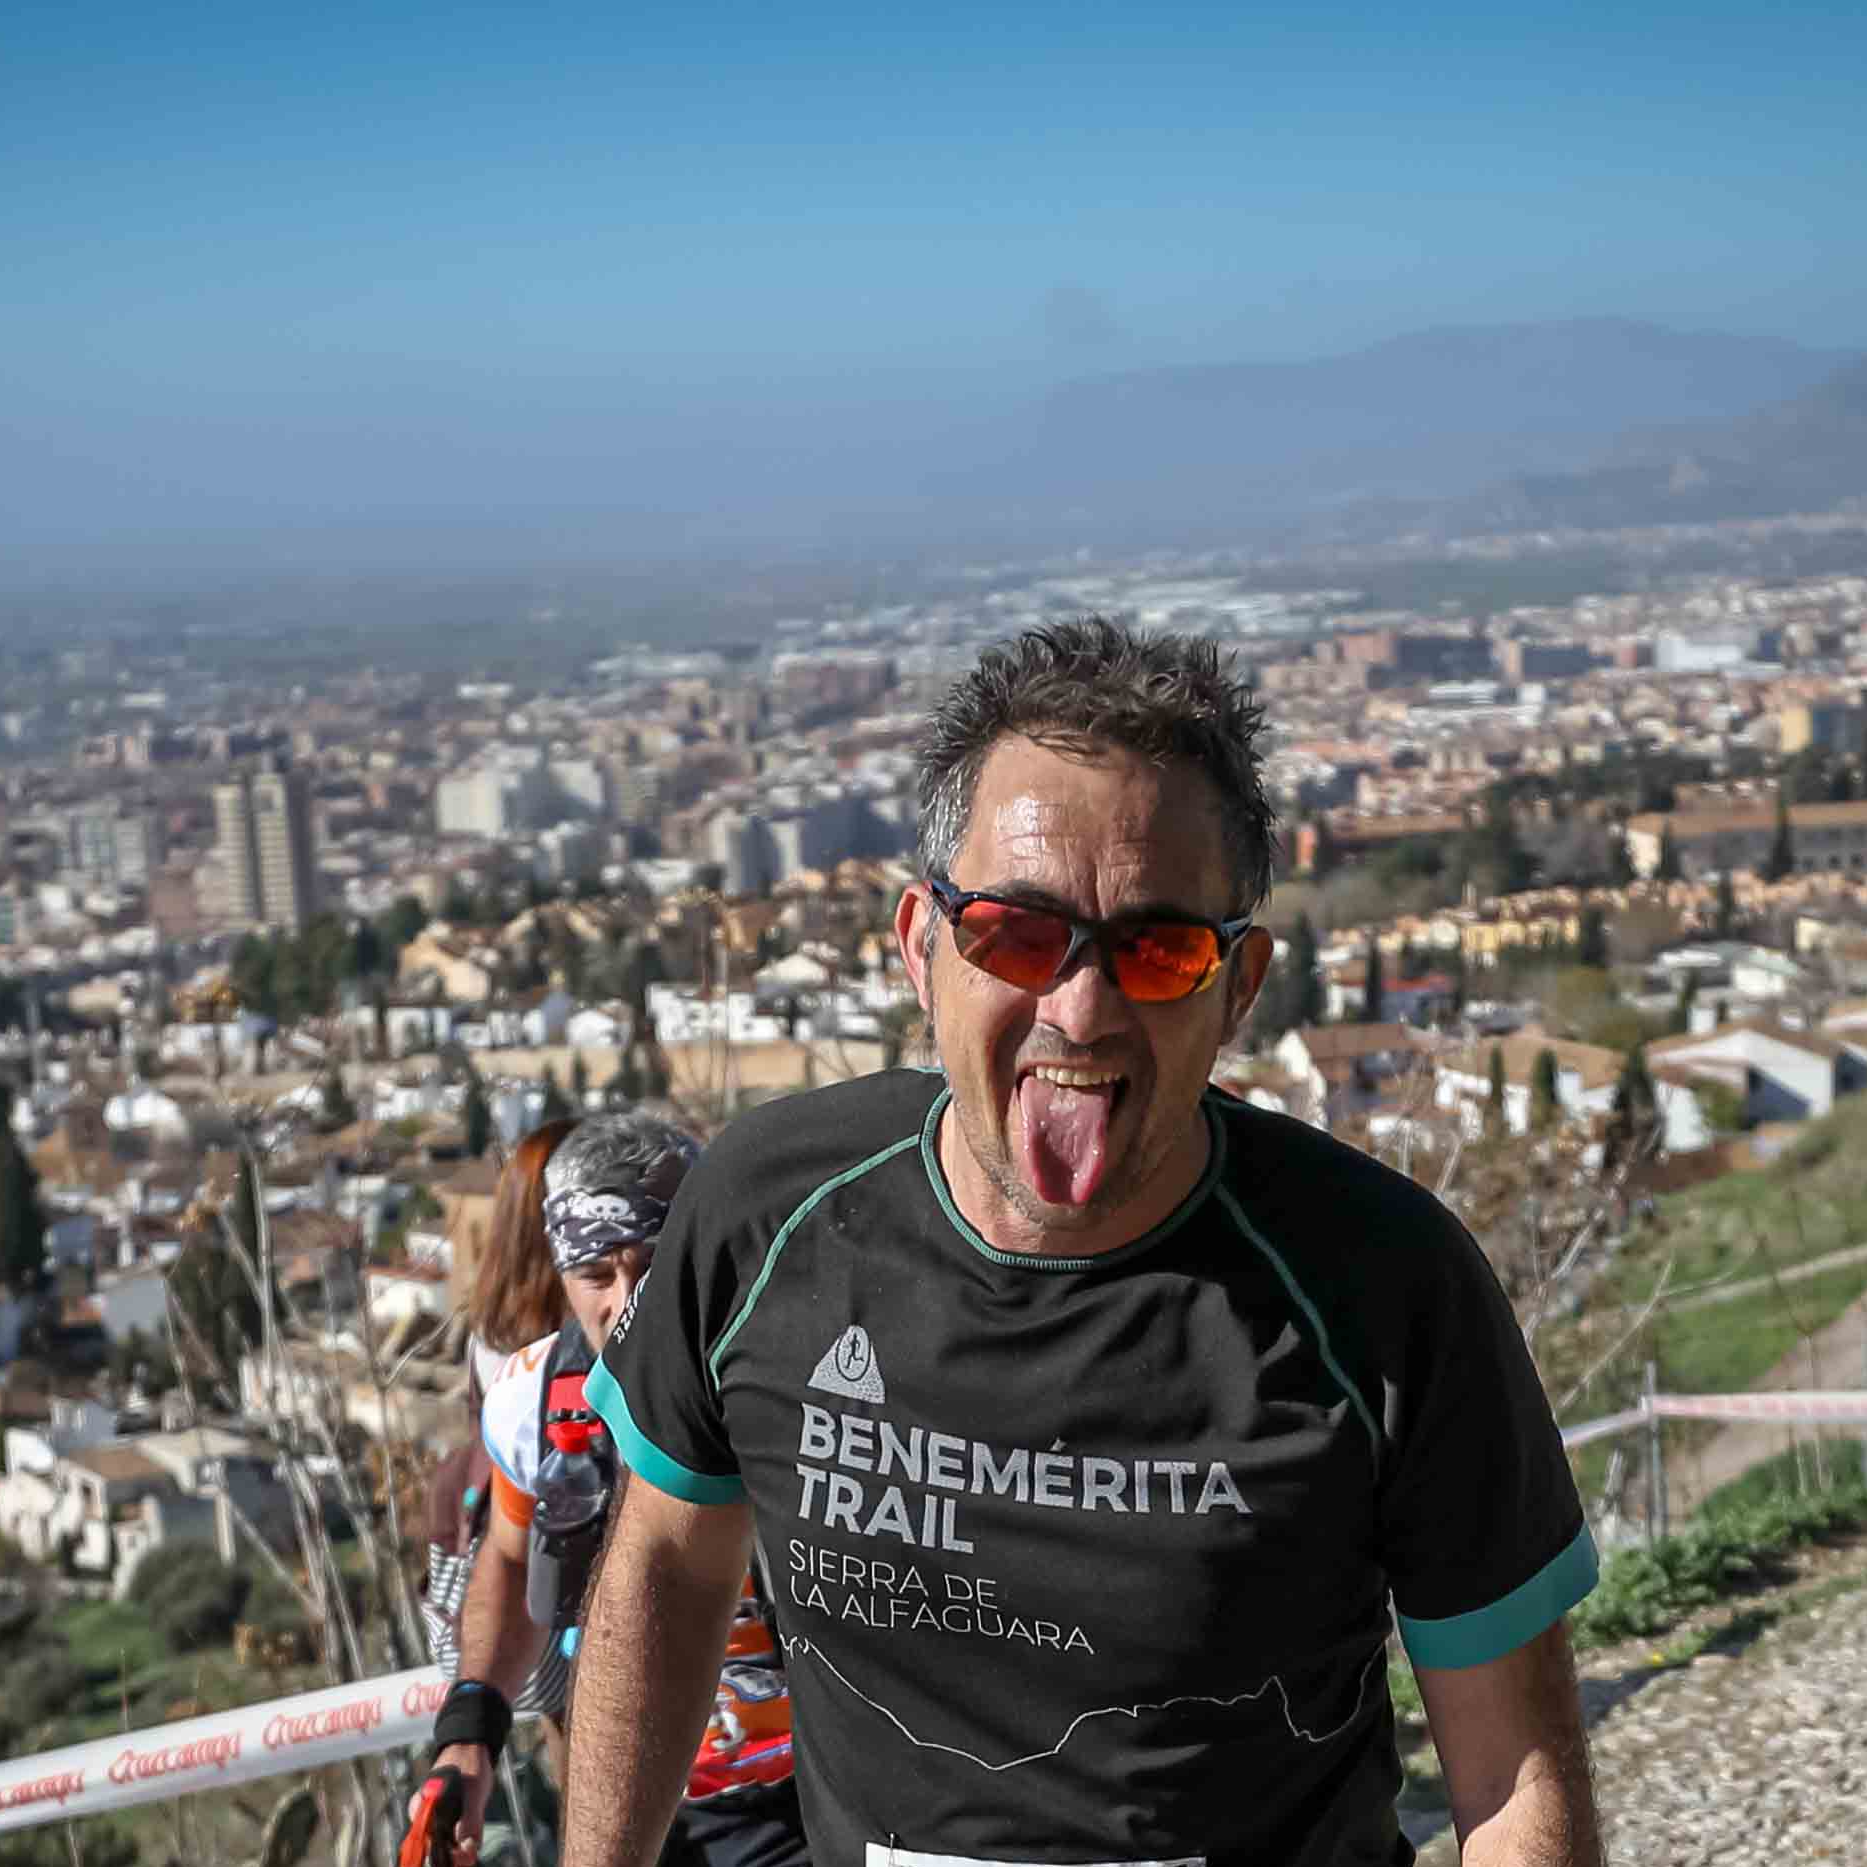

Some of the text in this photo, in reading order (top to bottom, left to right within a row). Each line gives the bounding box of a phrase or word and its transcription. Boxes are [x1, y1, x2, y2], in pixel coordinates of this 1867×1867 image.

[797, 1401, 1252, 1516] BENEMÉRITA
[795, 1462, 975, 1555] TRAIL
[789, 1538, 998, 1612] SIERRA DE
[789, 1578, 1095, 1656] LA ALFAGUARA
